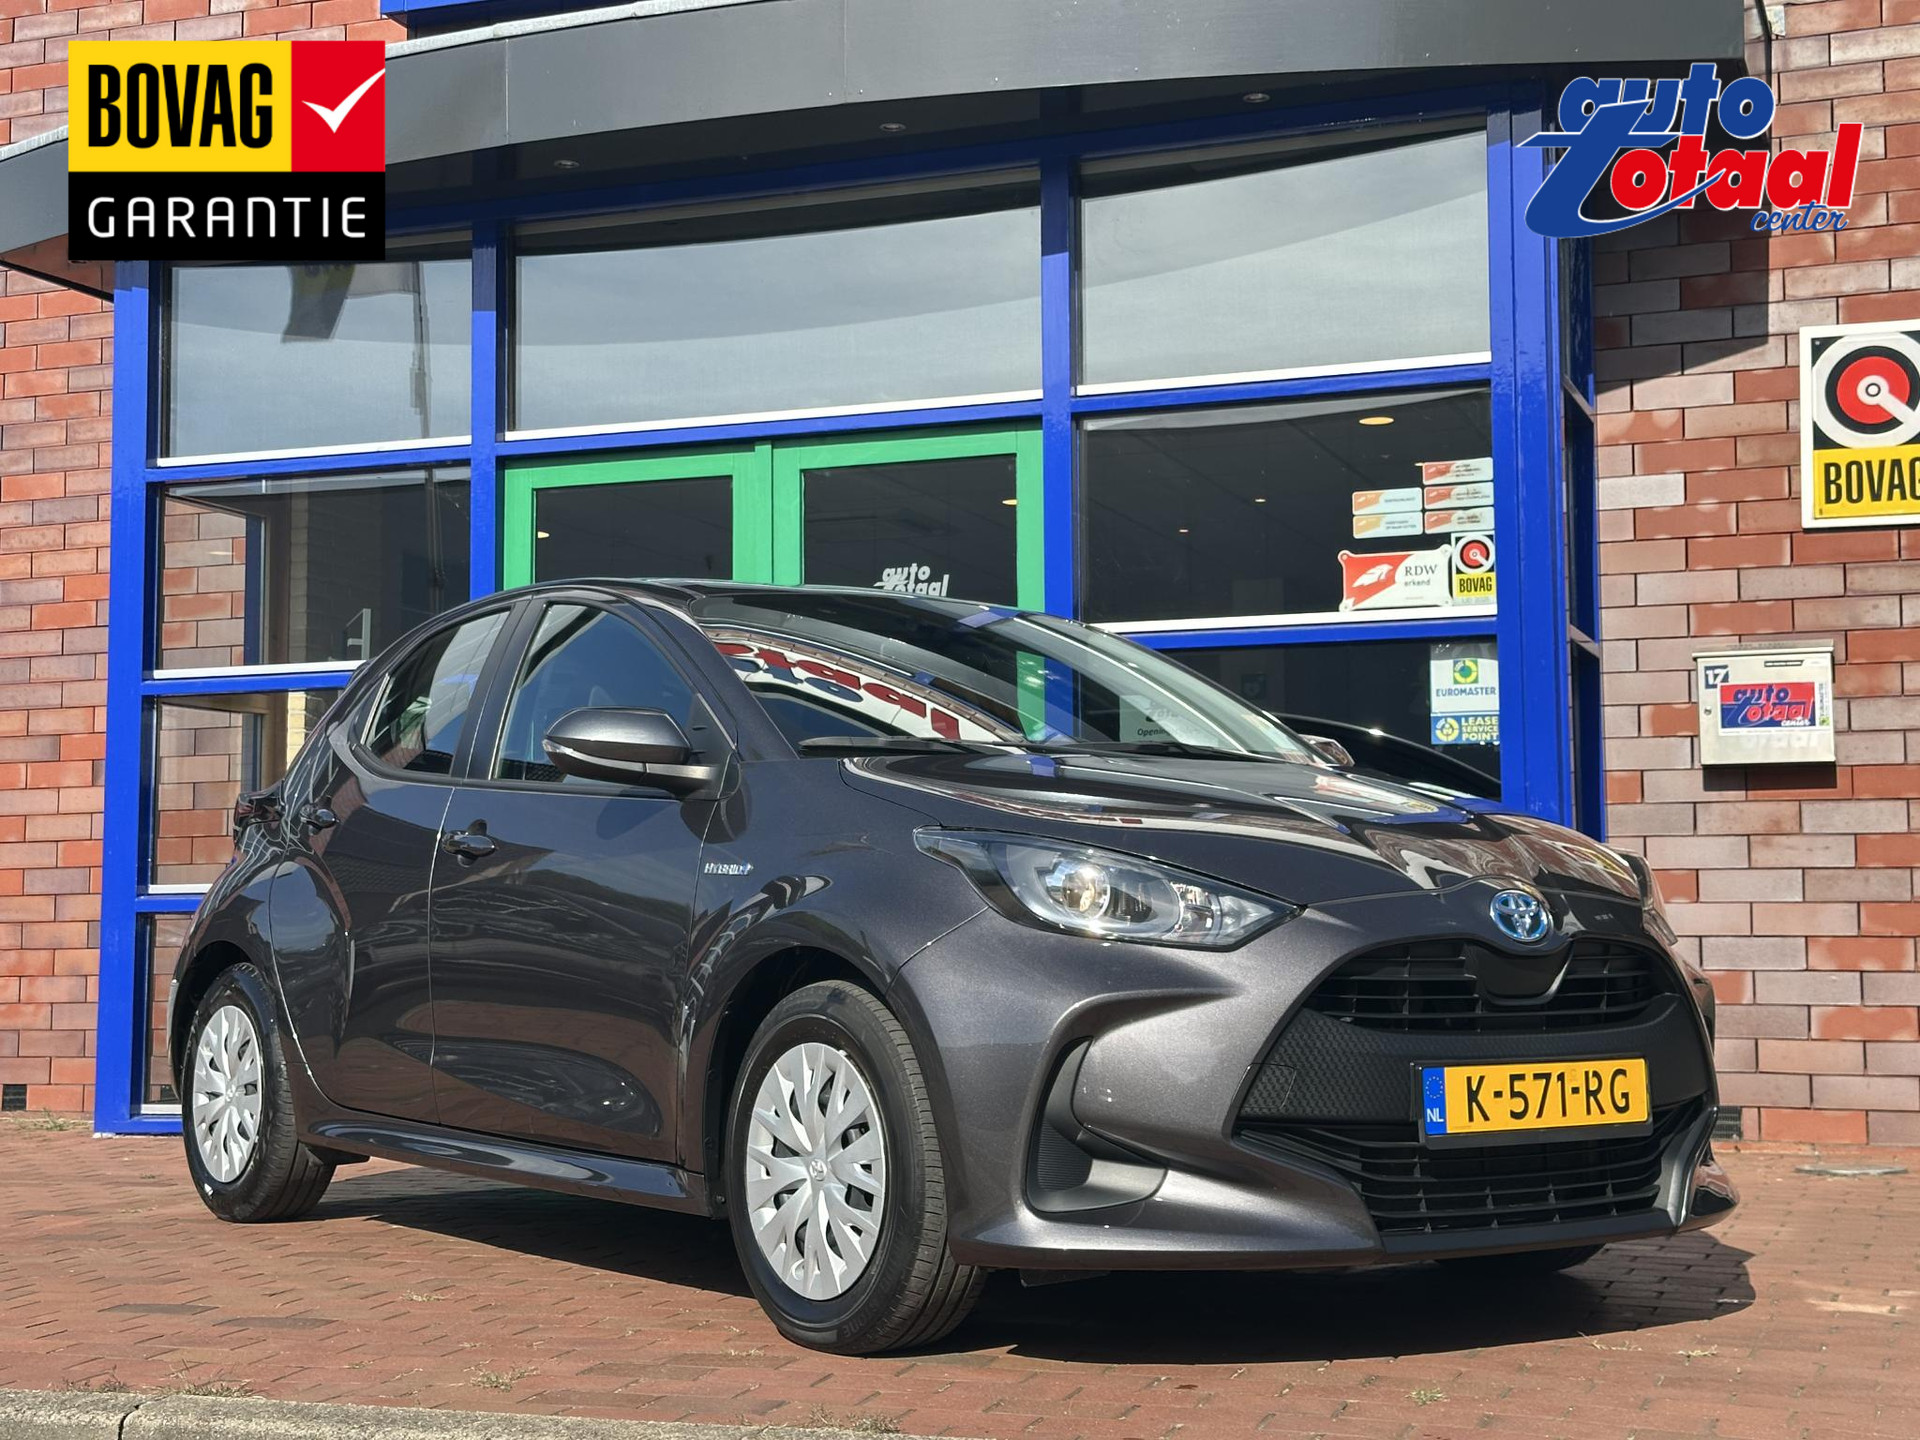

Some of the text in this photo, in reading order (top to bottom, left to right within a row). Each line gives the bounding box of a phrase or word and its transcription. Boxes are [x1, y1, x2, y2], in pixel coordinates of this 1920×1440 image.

[1823, 456, 1920, 505] BOVAG
[882, 563, 931, 583] auto
[1404, 564, 1438, 577] RDW
[1404, 579, 1431, 587] erkend
[1459, 576, 1492, 593] BOVAG
[1706, 668, 1729, 686] 17
[1436, 687, 1496, 697] EUROMASTER
[1733, 683, 1790, 703] auto
[1461, 716, 1499, 726] LEASE
[1462, 725, 1498, 733] SERVICE
[1462, 732, 1499, 741] POINT
[1466, 1068, 1631, 1123] K-571-RG
[1427, 1108, 1444, 1122] NL
